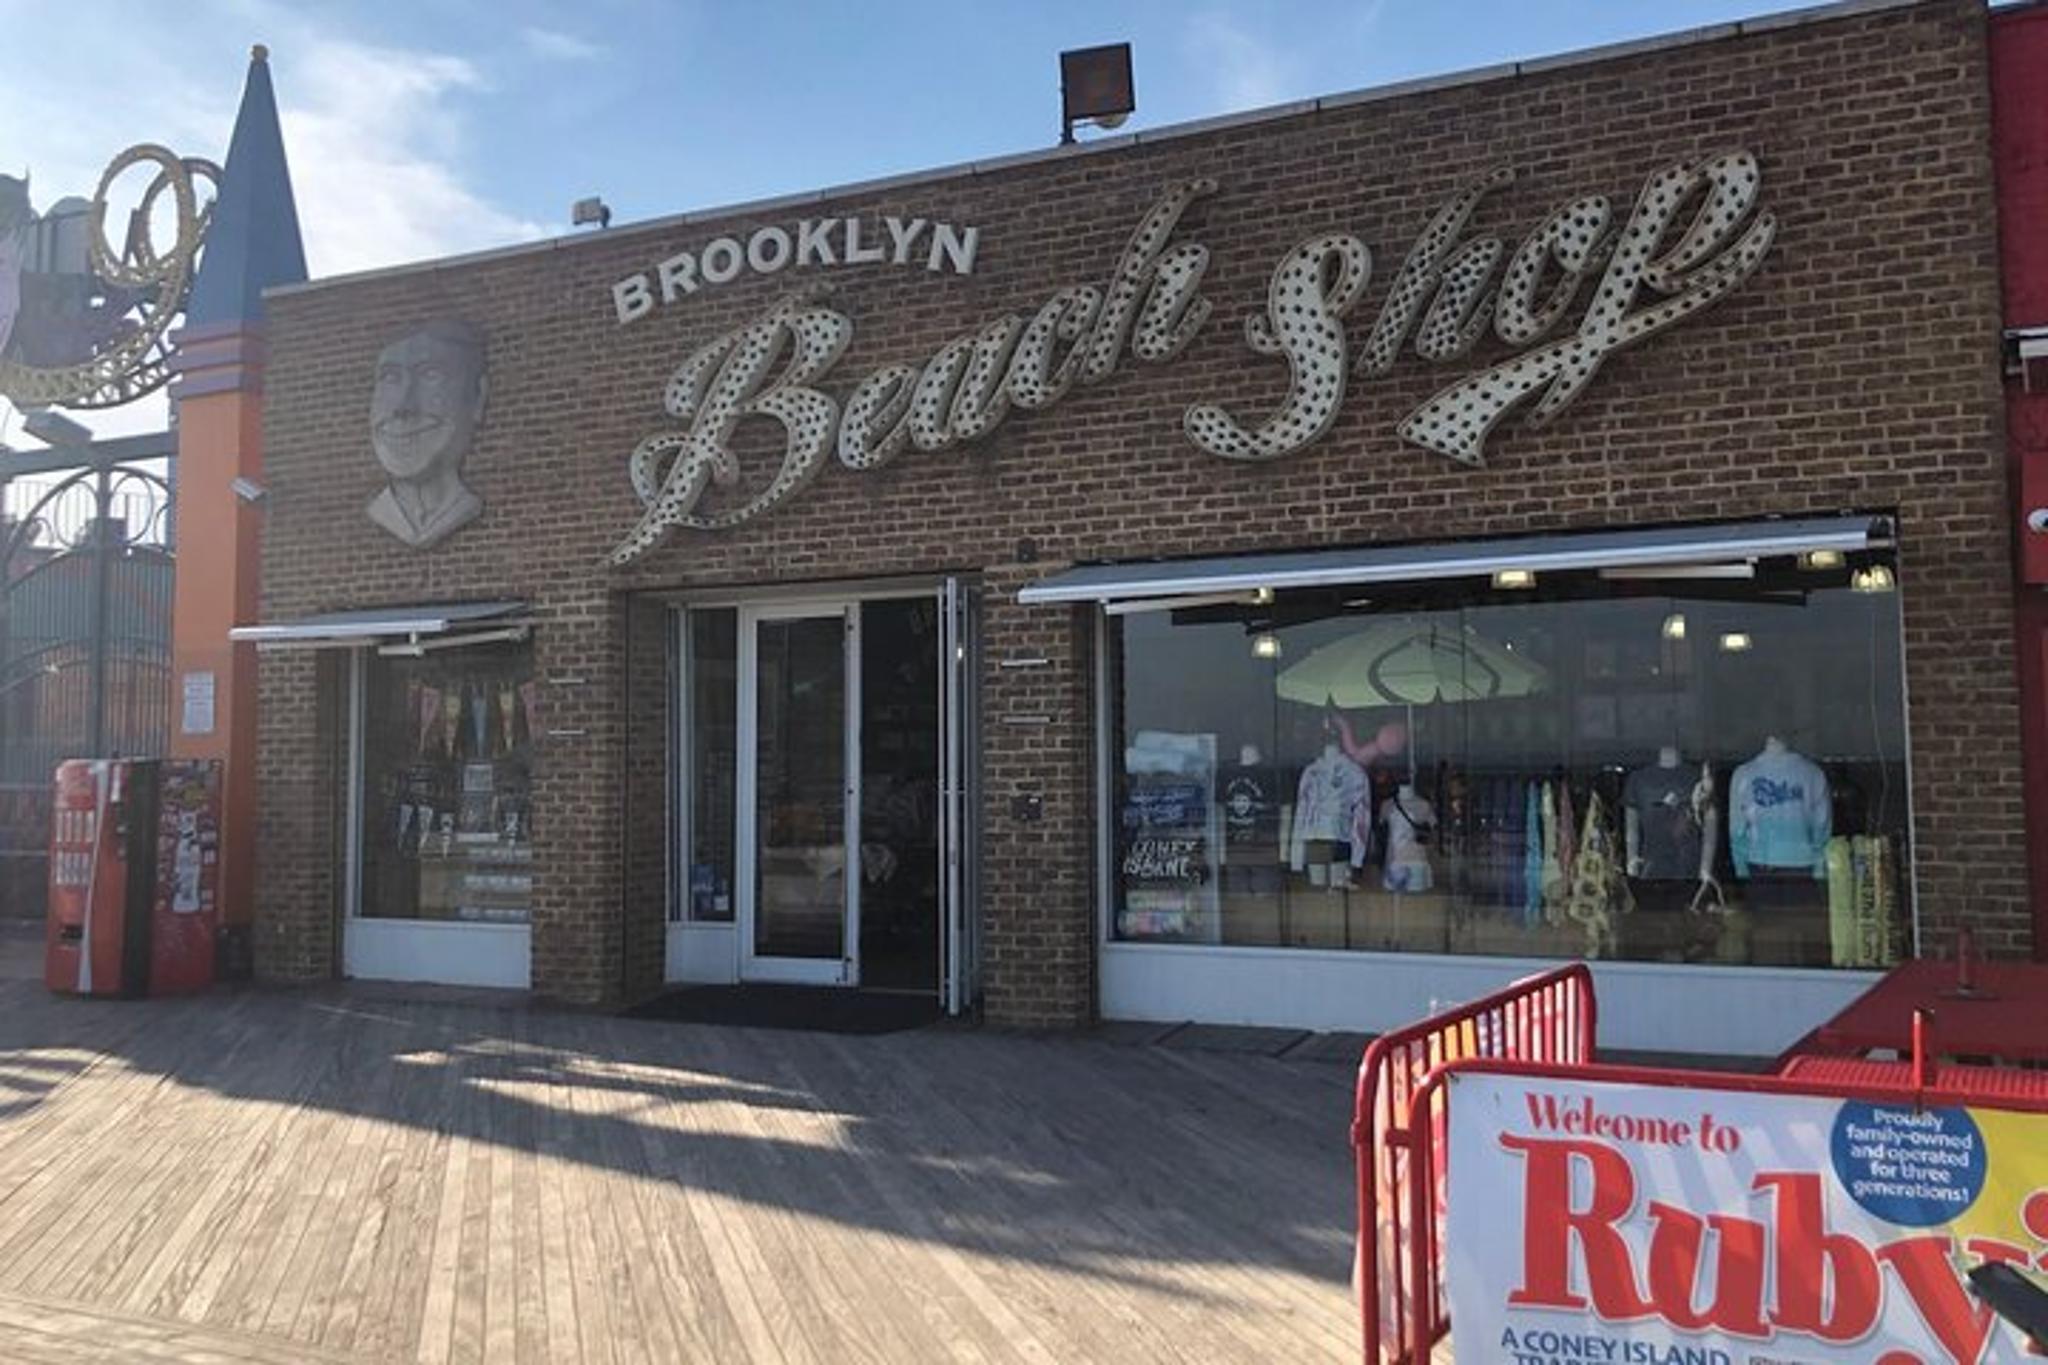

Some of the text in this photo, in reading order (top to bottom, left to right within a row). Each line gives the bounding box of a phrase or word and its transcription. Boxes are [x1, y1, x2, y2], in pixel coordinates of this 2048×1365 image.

[612, 217, 980, 323] BROOKLYN
[610, 148, 1776, 566] Beach Shop
[1523, 1092, 1741, 1154] Welcome to
[1873, 1109, 1943, 1132] Proudly
[1846, 1123, 1973, 1150] family-owned
[1851, 1143, 1970, 1168] and operated
[1870, 1161, 1952, 1184] for three
[1853, 1180, 1969, 1203] generations!
[1501, 1327, 1519, 1349] A
[1523, 1331, 1617, 1360] CONEY
[1623, 1341, 1730, 1365] ISLAND
